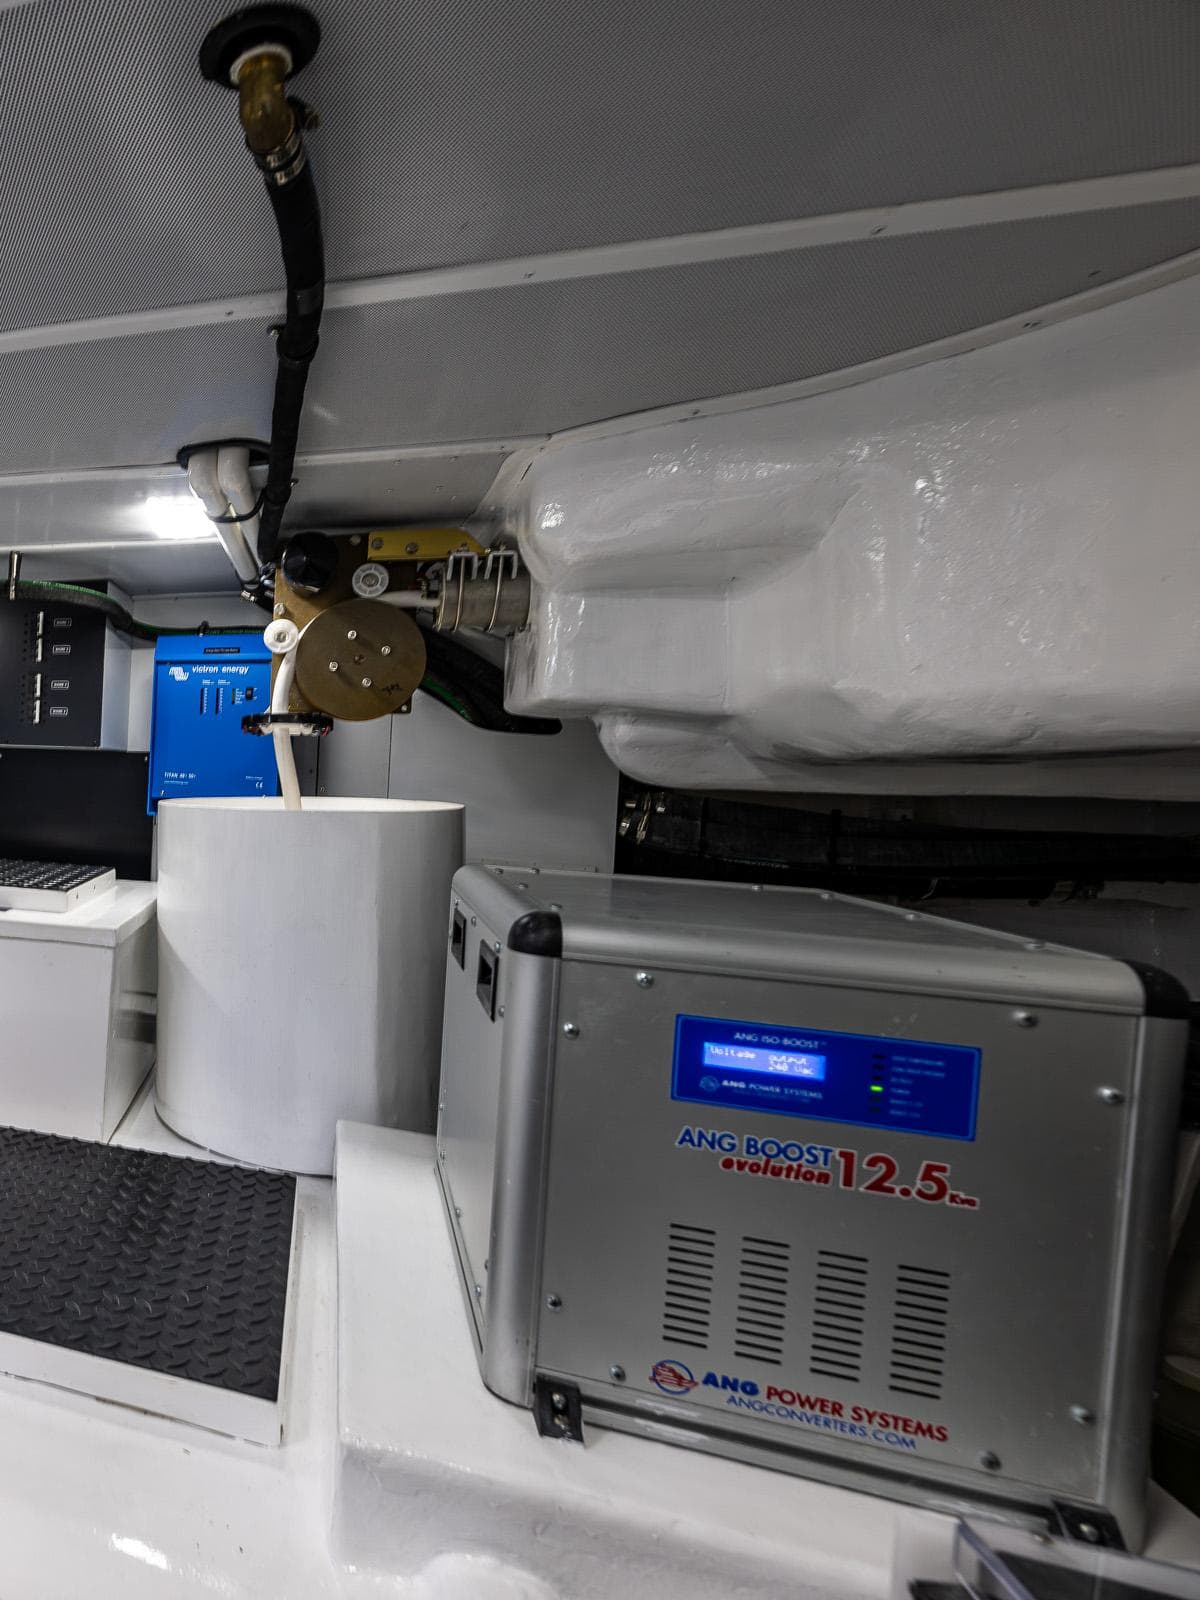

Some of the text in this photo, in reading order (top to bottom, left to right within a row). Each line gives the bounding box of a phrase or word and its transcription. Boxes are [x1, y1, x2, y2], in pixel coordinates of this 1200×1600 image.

[192, 664, 249, 675] victron energy
[733, 1032, 819, 1049] ANG ISO BOOST
[721, 1079, 747, 1089] ANG
[748, 1082, 781, 1093] POWER
[783, 1087, 823, 1100] SYSTEMS
[677, 1127, 737, 1153] ANG
[745, 1136, 833, 1167] BOOST
[721, 1156, 832, 1185] evolution
[702, 1371, 949, 1442] ANG POWER SYSTEMS
[726, 1395, 917, 1450] ANGCONVERTERS.COM
